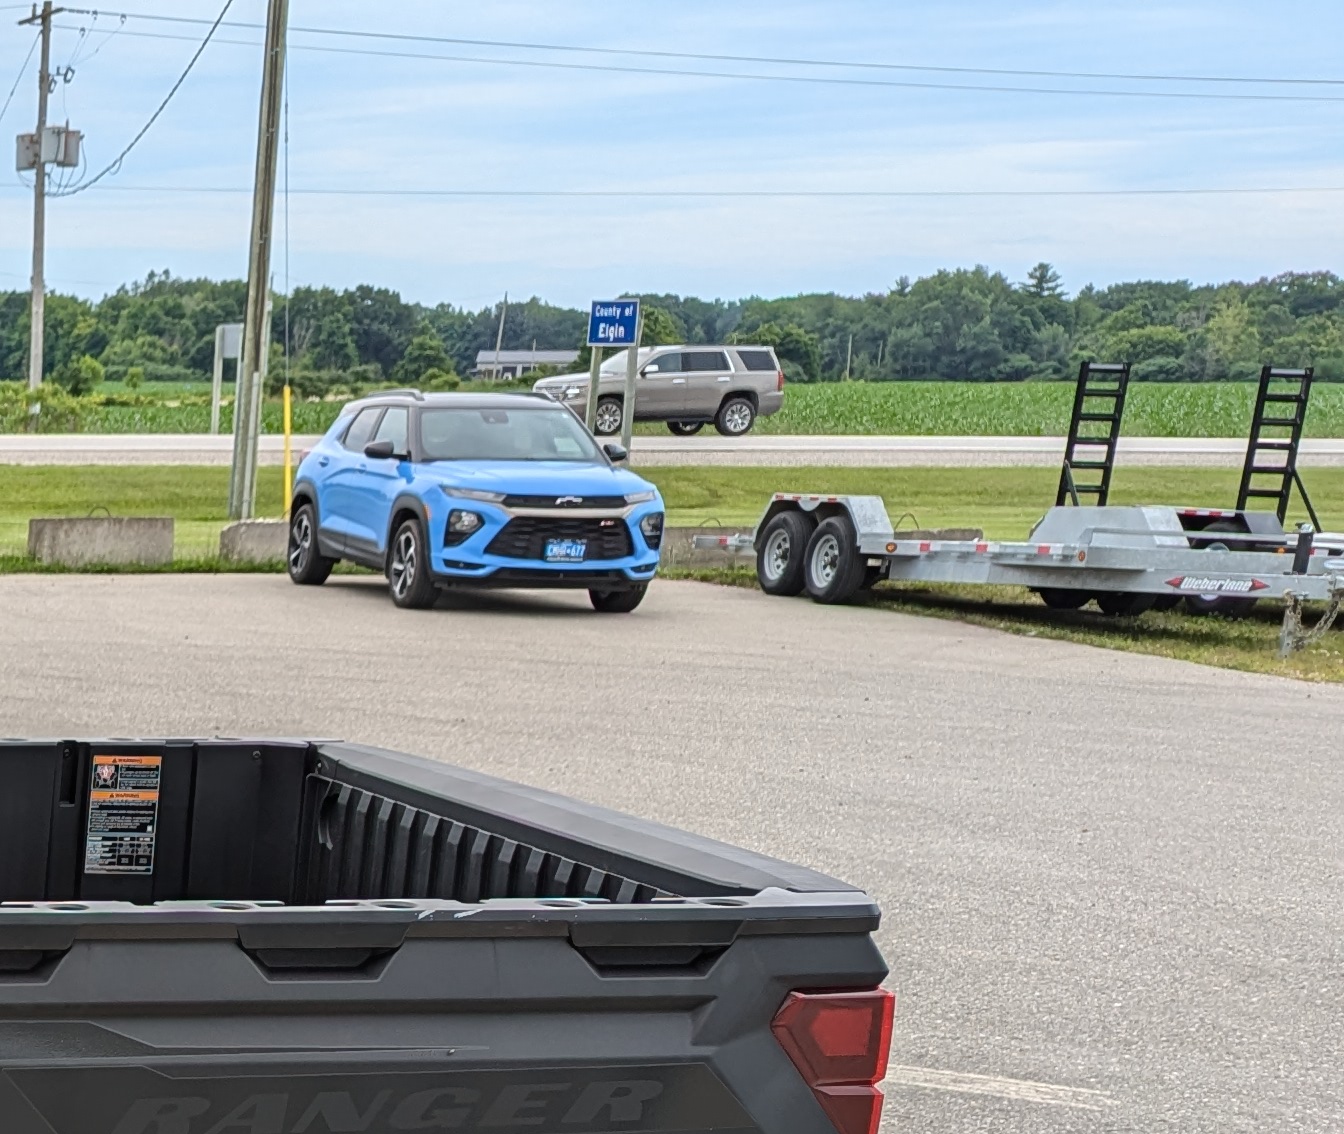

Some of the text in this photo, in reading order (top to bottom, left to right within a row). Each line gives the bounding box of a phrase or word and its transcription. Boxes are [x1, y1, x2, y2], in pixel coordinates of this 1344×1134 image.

[595, 303, 634, 320] County of
[598, 322, 625, 342] Elgin
[1180, 576, 1253, 592] Weberlane
